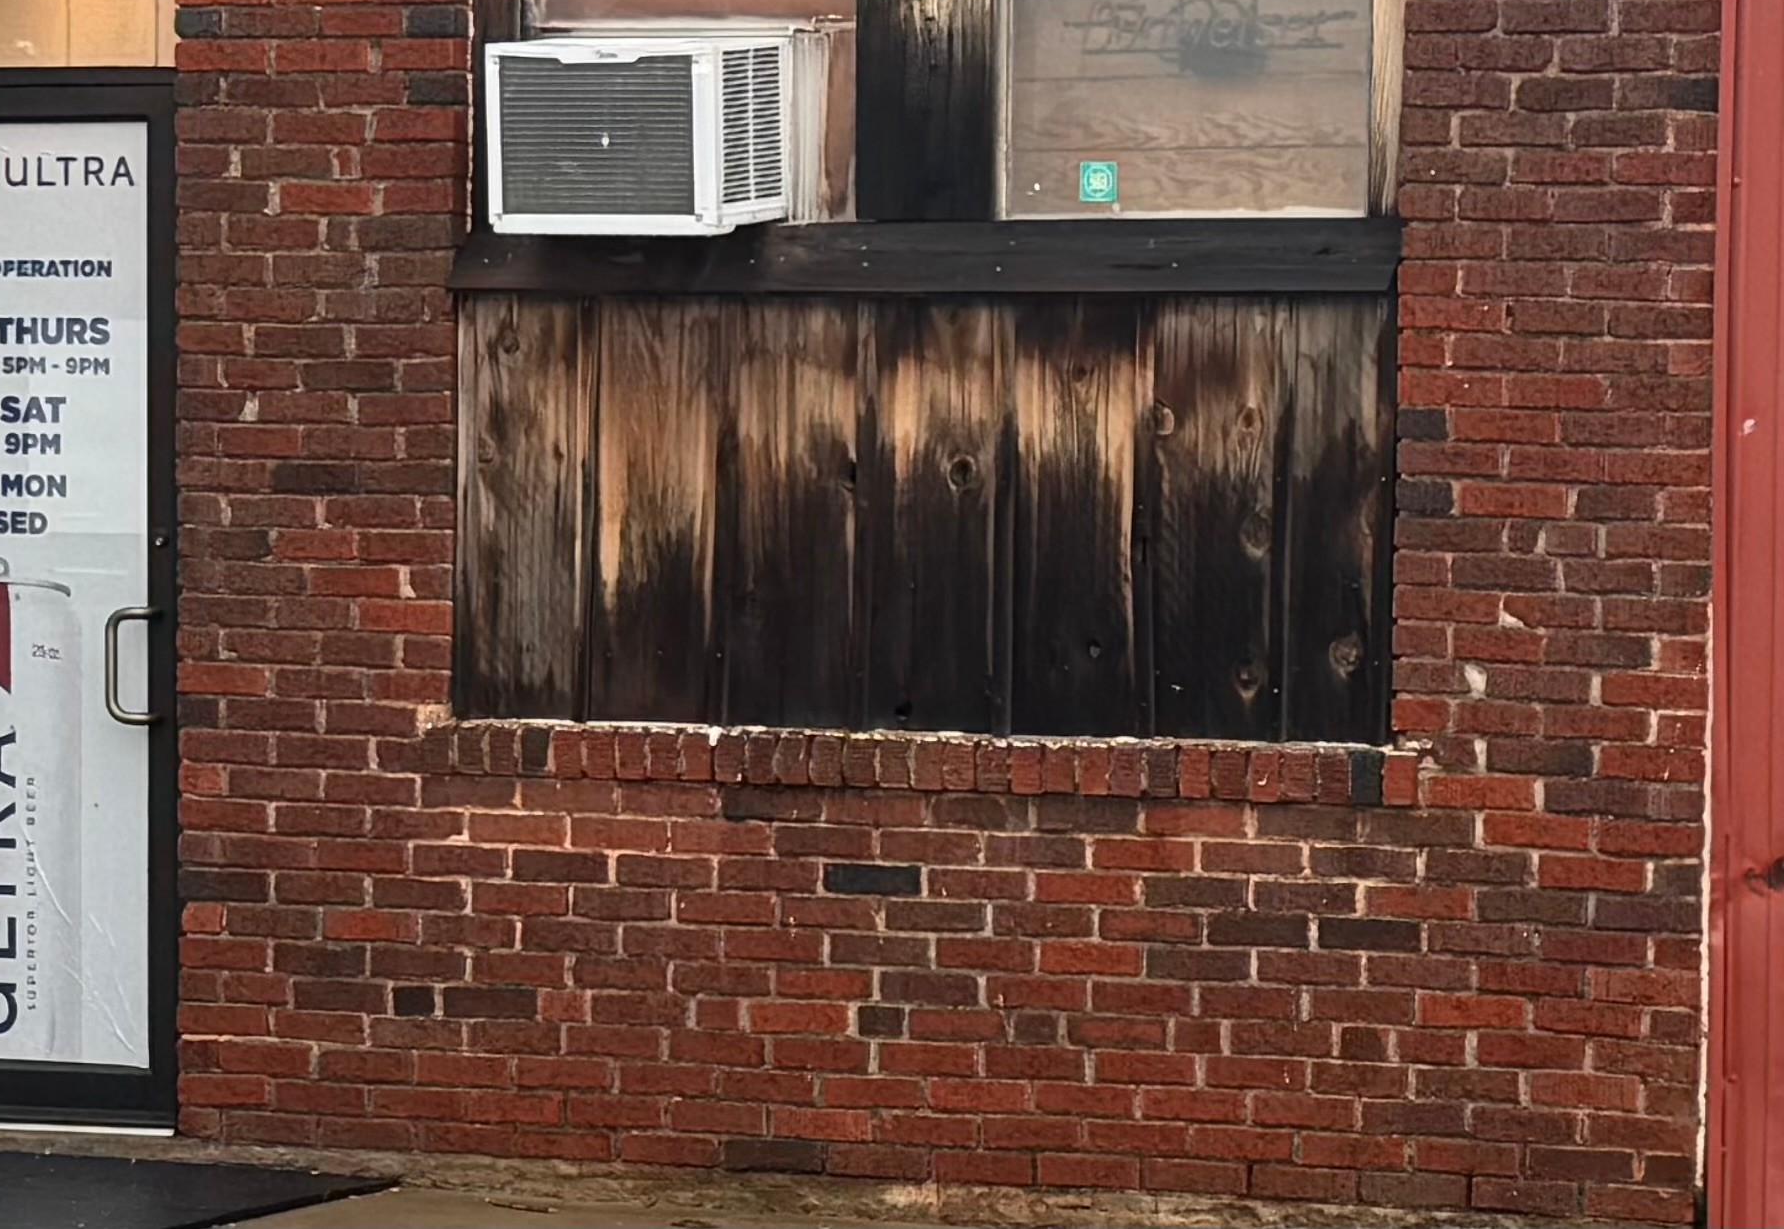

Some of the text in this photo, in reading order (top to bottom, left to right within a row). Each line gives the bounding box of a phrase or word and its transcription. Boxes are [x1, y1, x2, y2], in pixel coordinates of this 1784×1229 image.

[5, 156, 135, 187] ULTRA
[2, 357, 46, 374] 5PM
[65, 357, 110, 375] 9PM
[0, 396, 66, 424] SAT
[5, 433, 61, 455] 9PM
[1, 475, 67, 498] MON
[27, 776, 36, 826] BEER
[26, 838, 36, 897] LIGHT
